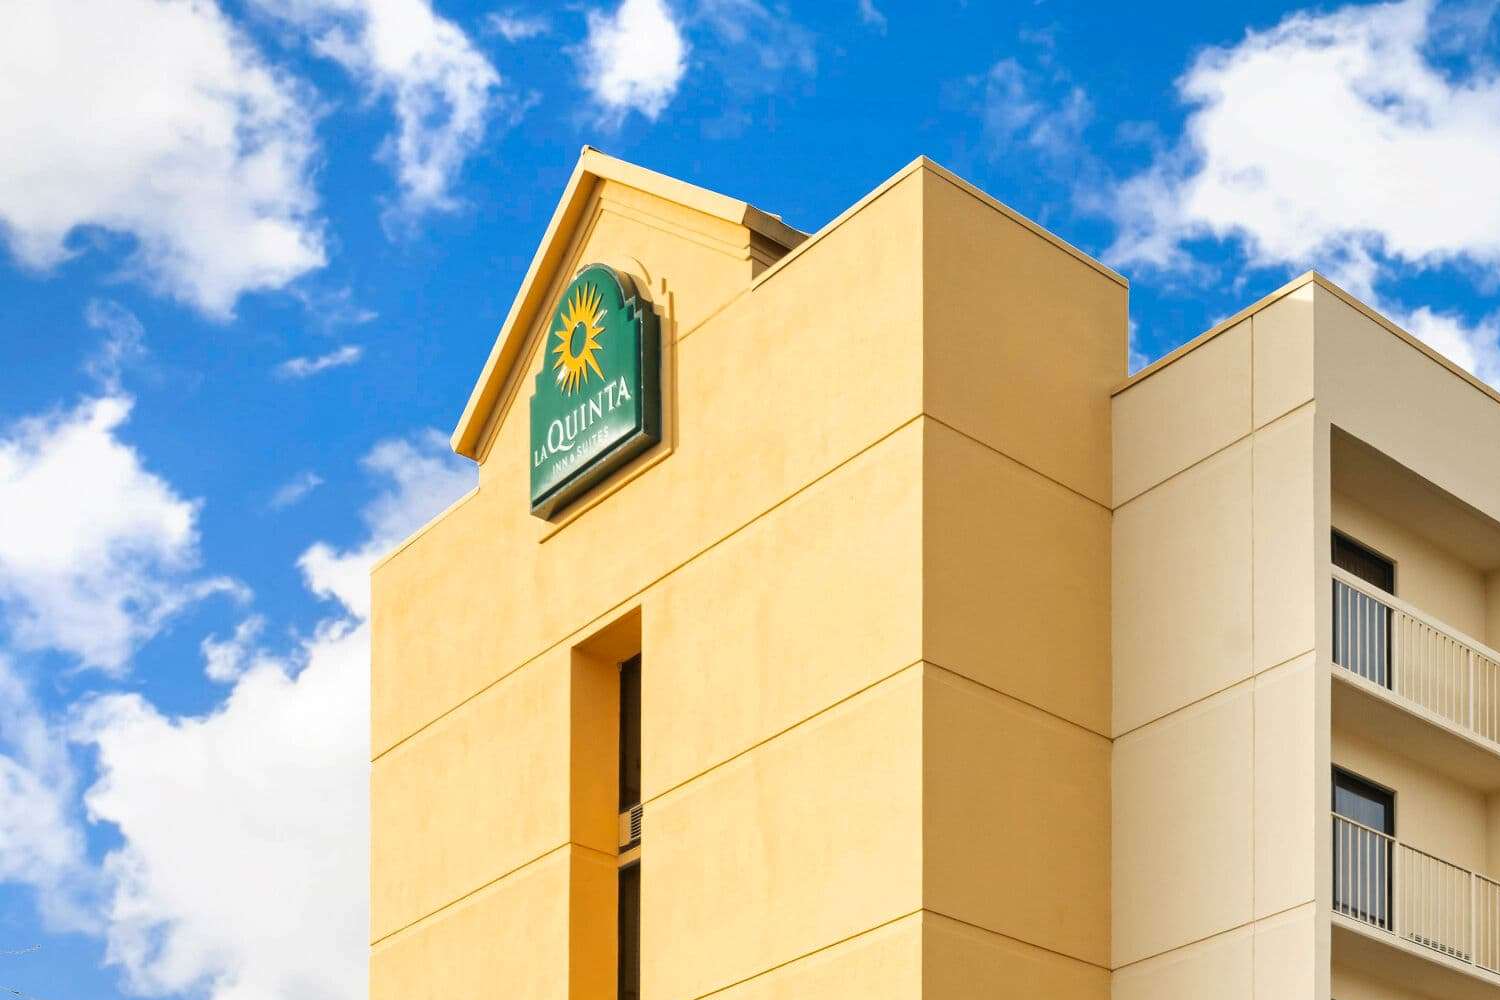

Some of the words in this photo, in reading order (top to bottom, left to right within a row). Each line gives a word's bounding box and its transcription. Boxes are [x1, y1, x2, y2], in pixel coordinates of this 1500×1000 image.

[534, 445, 549, 467] LA
[547, 375, 632, 454] QUINTA
[552, 456, 569, 475] INN
